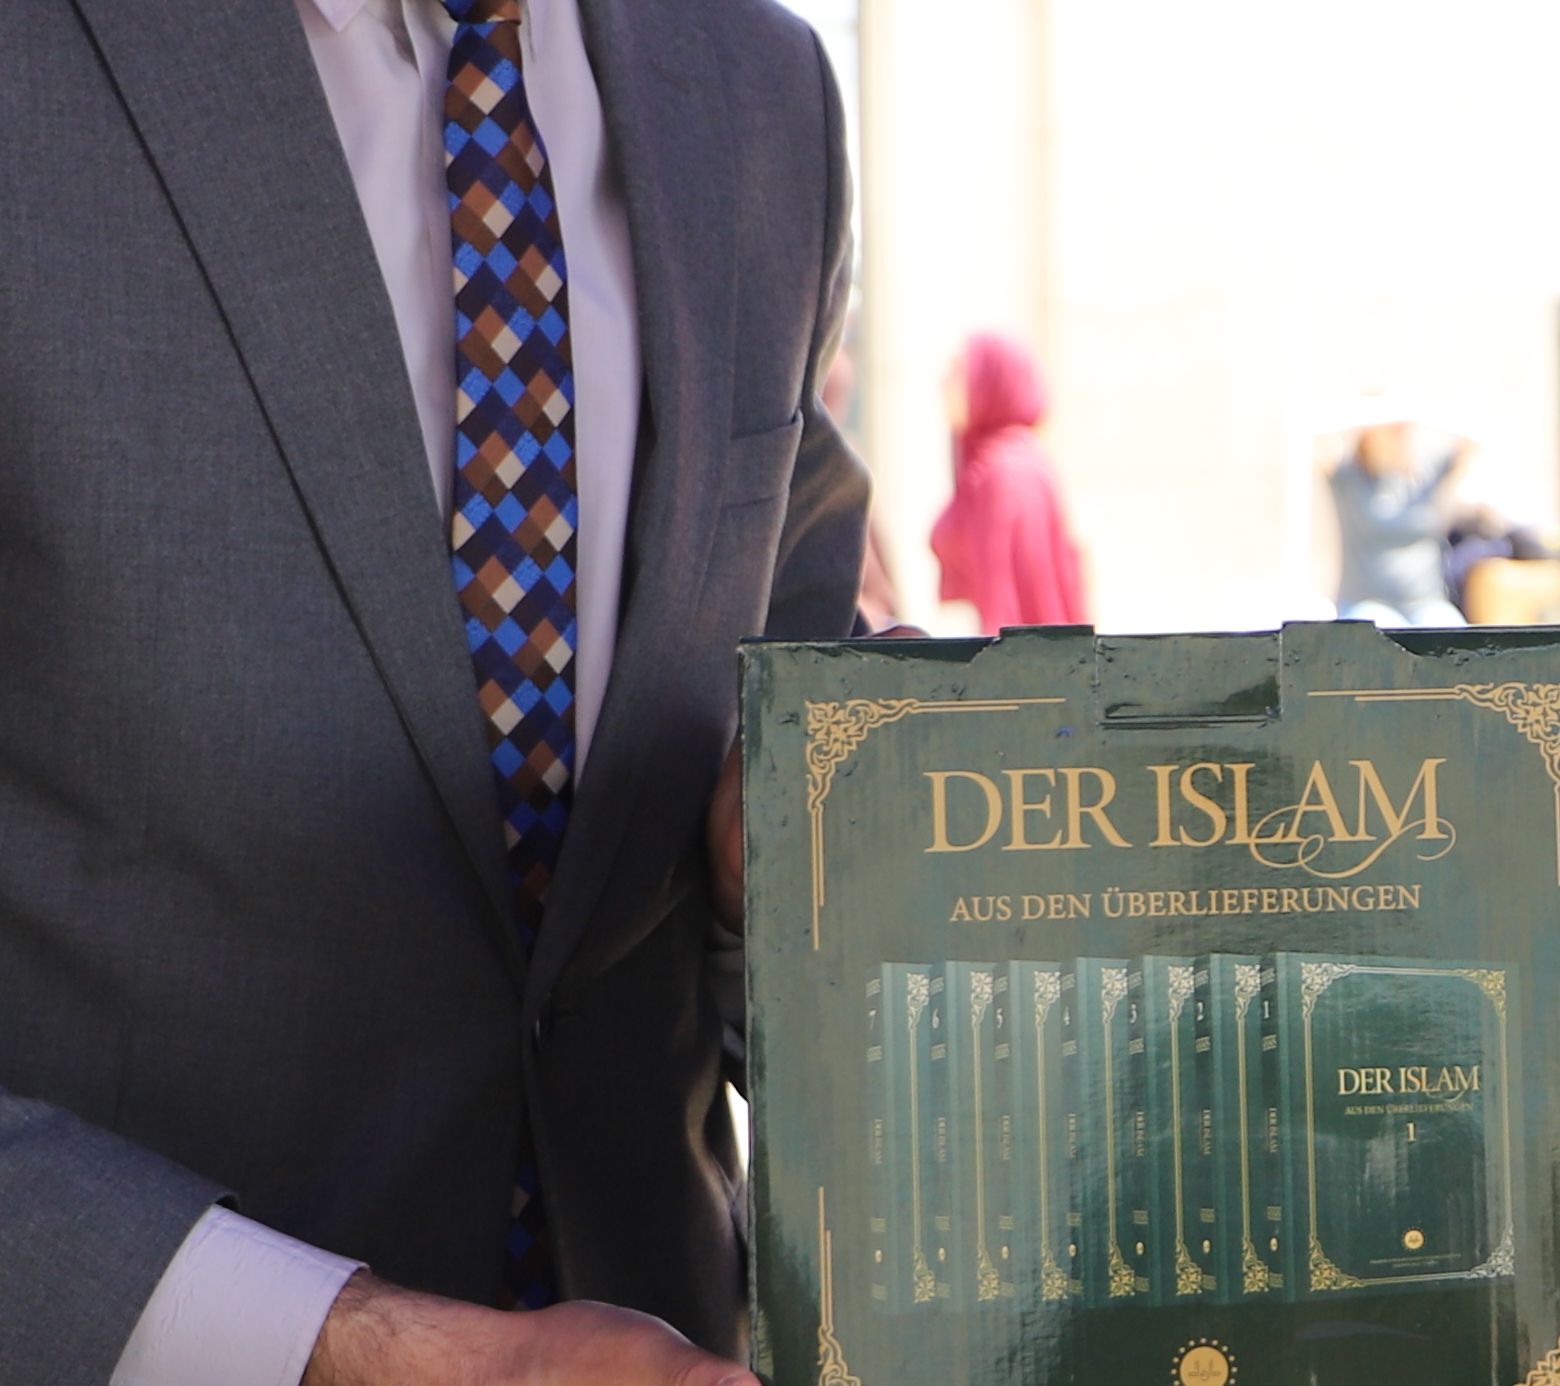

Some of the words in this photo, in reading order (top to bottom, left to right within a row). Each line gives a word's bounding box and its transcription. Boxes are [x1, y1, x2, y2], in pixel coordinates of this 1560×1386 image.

[924, 767, 1132, 854] DER
[1148, 758, 1457, 878] ISLAM
[949, 894, 1012, 923] AUS
[1021, 891, 1093, 920] DEN
[1102, 883, 1423, 918] ÜBERLIEFERUNGEN
[1338, 1068, 1394, 1095] DER
[1399, 1065, 1480, 1102] ISLAM
[1406, 1121, 1417, 1142] 1
